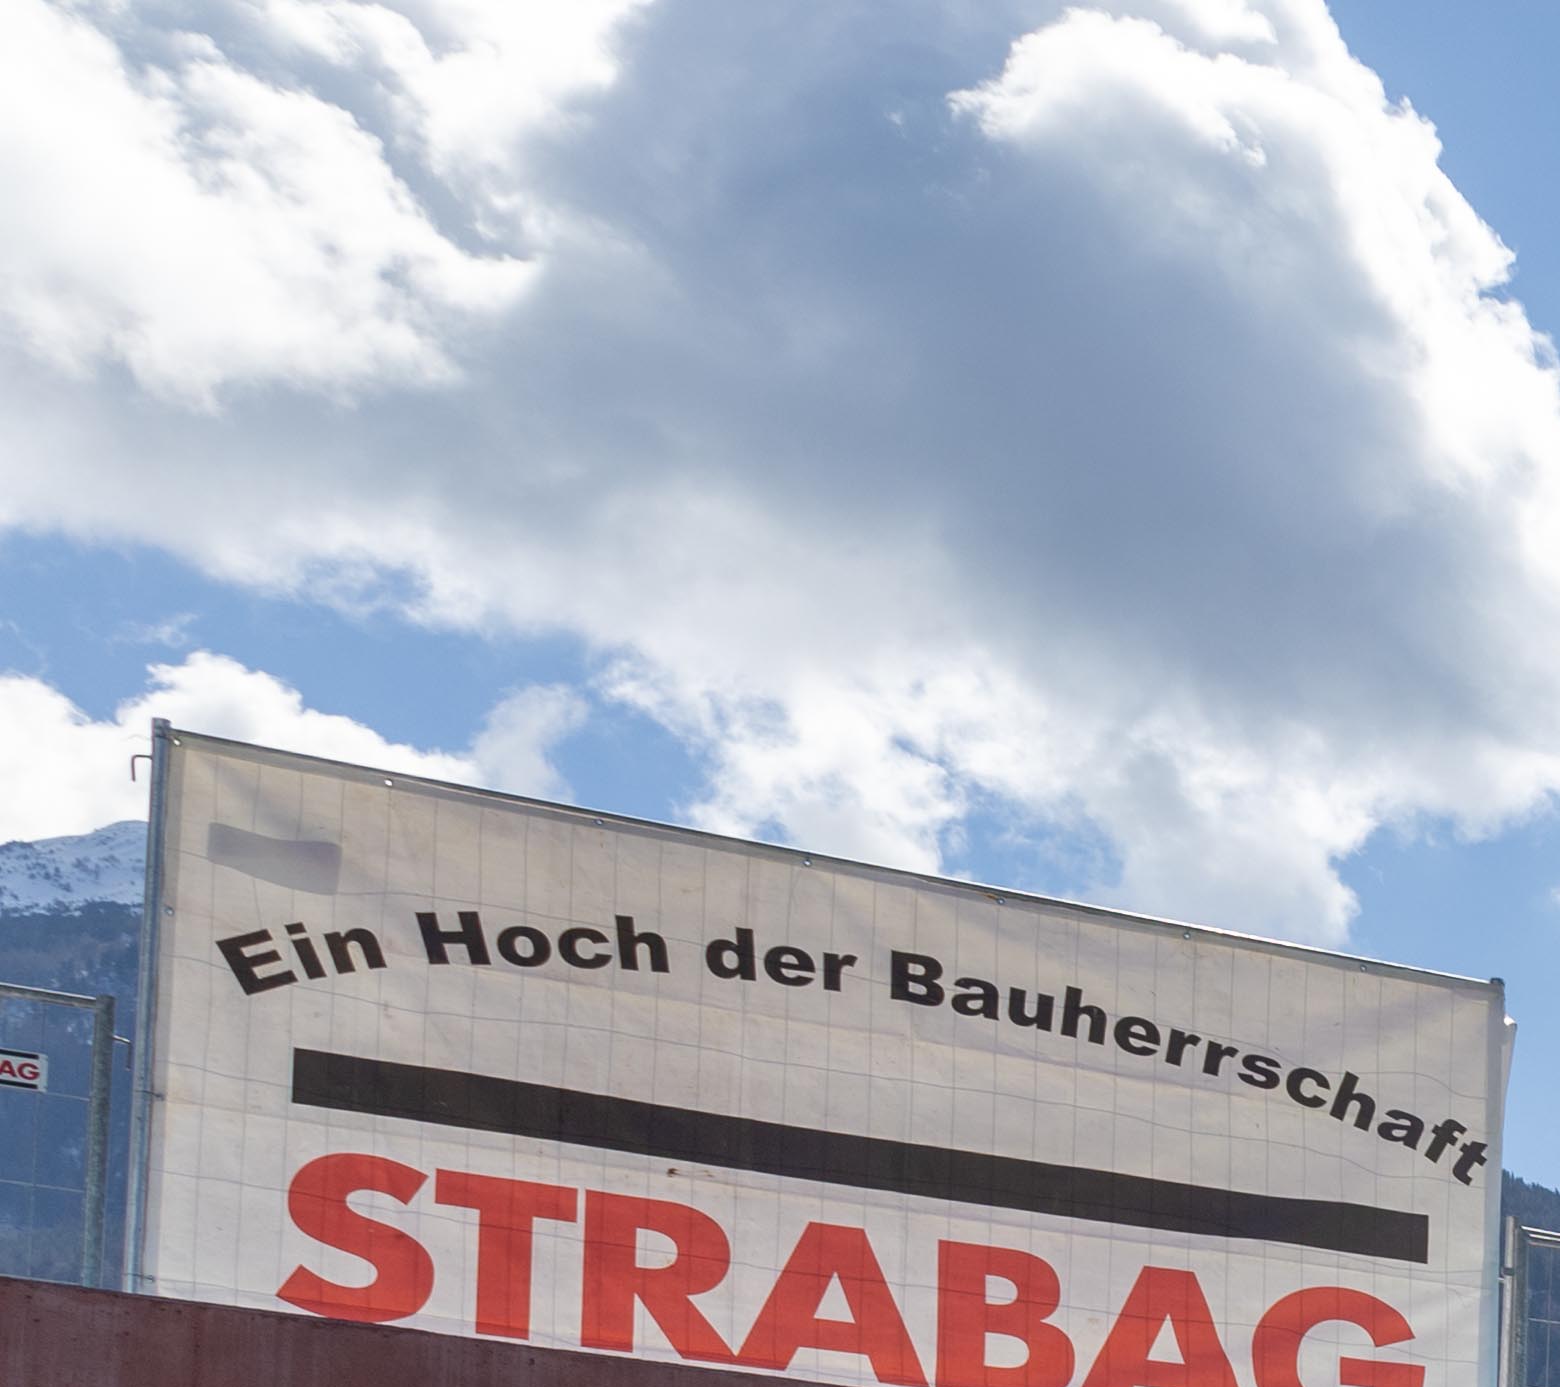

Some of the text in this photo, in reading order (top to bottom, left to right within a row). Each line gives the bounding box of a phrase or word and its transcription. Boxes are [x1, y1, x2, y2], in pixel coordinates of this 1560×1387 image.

[215, 911, 1489, 1187] Ein Hoch der Bauherrschaft
